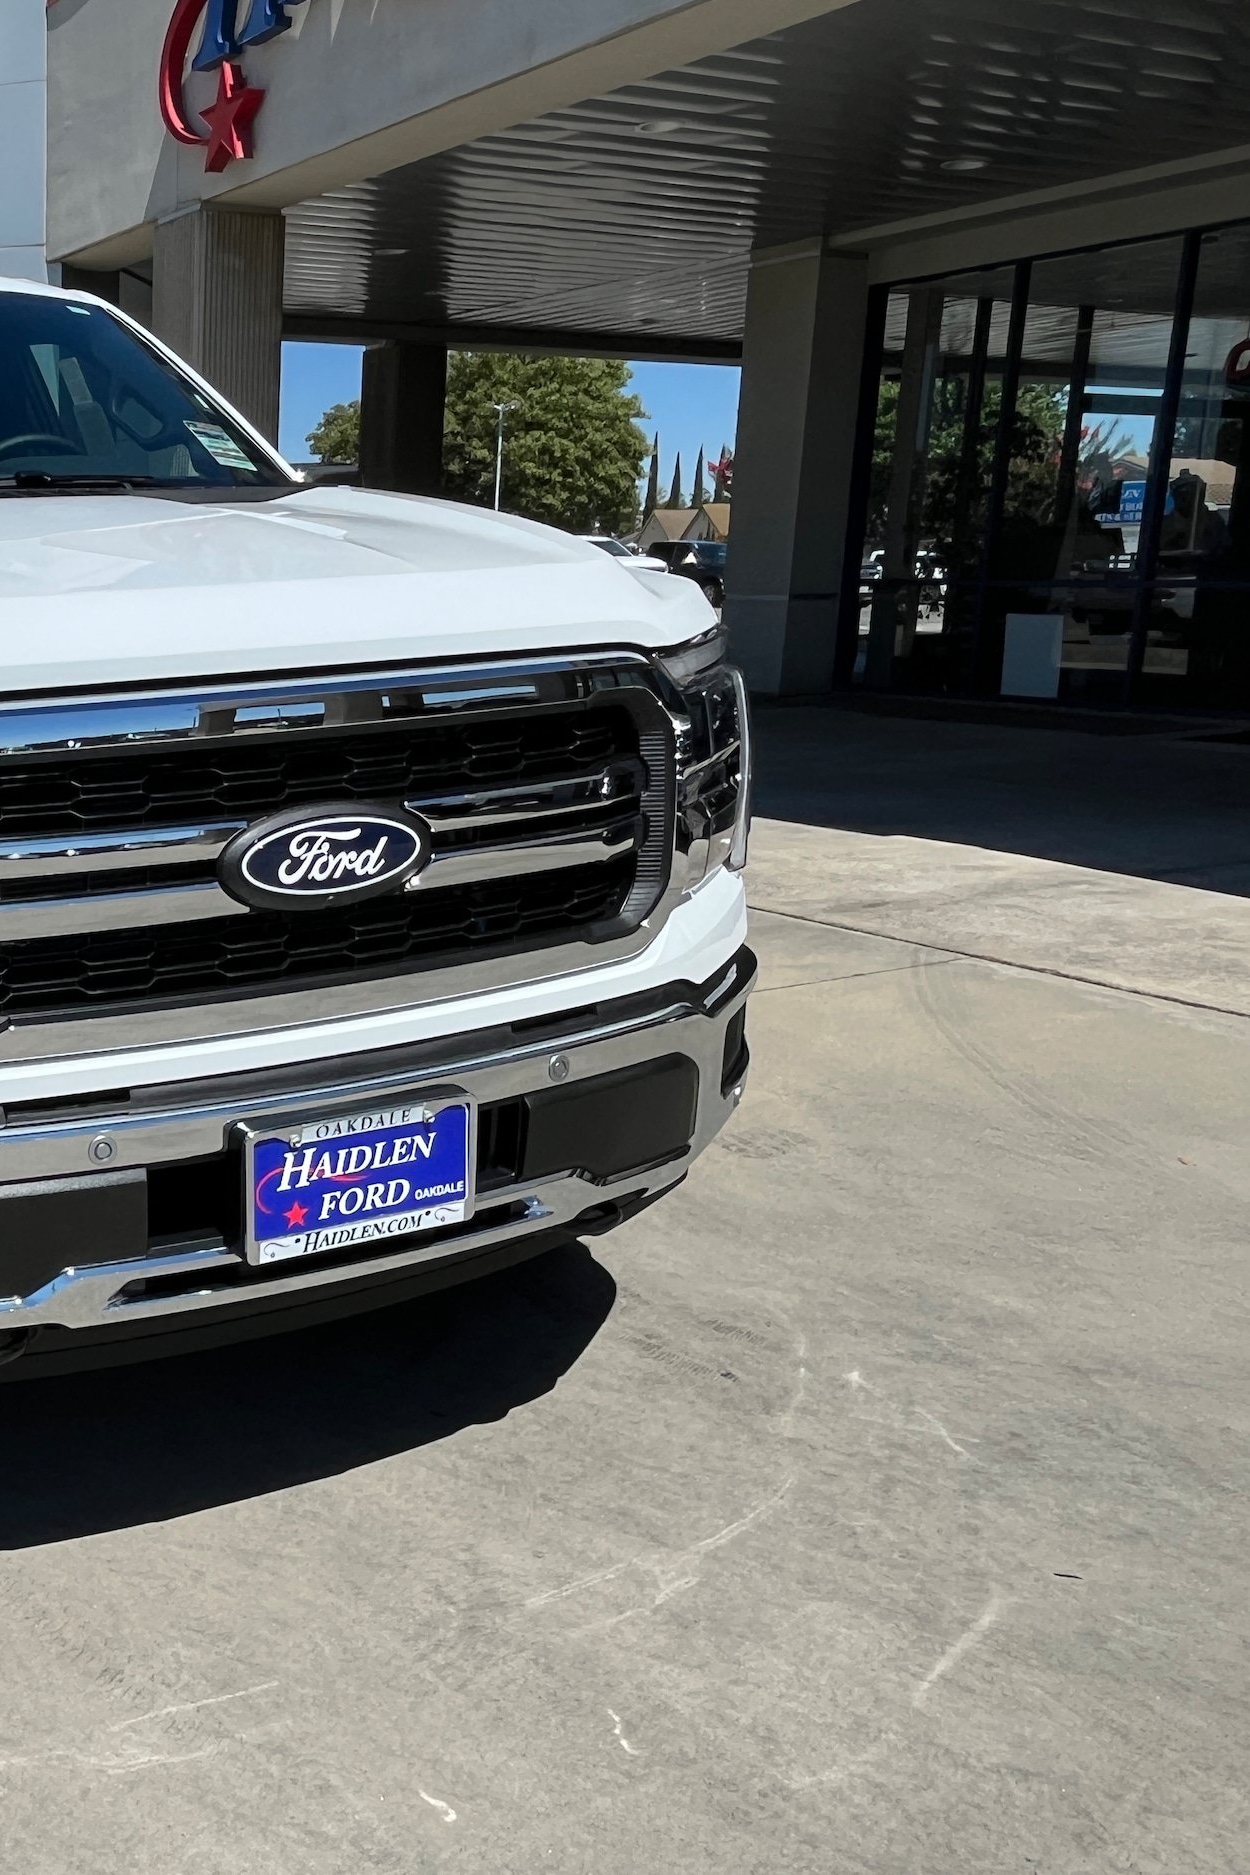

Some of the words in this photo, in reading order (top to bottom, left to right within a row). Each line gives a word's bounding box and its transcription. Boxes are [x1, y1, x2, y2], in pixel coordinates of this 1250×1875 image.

[278, 828, 388, 884] Ford
[316, 1109, 411, 1139] OAKDALE
[277, 1132, 437, 1192] HAIDLEN
[318, 1178, 410, 1220] FORD
[414, 1180, 464, 1200] OAKDALE
[304, 1214, 423, 1253] HAIDLEN.COM
